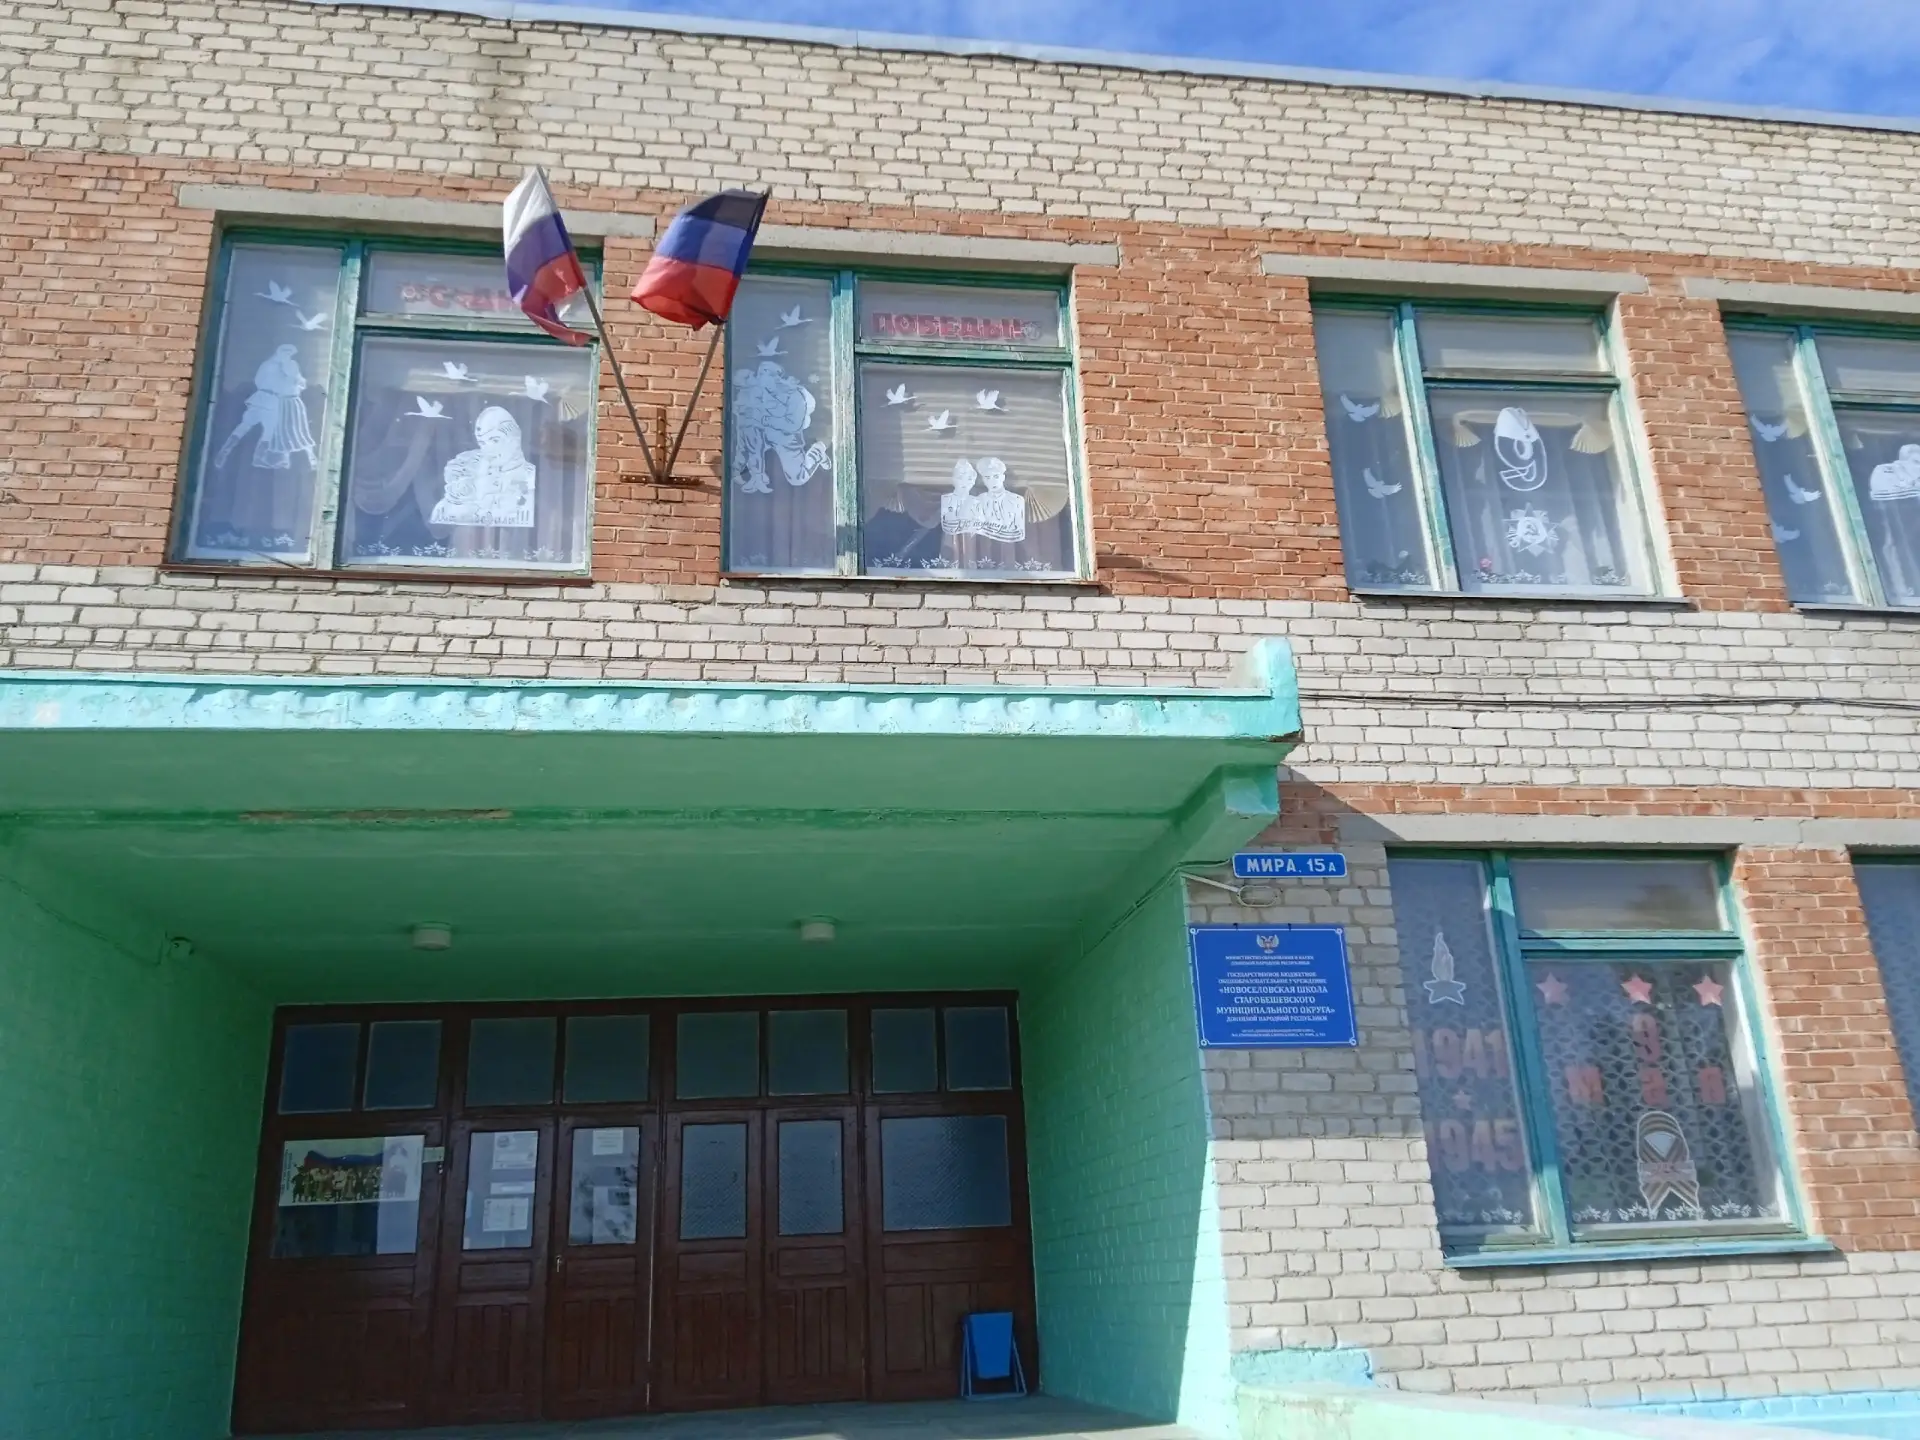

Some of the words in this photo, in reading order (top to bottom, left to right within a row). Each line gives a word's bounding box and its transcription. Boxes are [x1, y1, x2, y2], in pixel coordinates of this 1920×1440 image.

[1219, 985, 1296, 994] «НОВОСЕЛОВСКАЯ
[1297, 985, 1328, 994] ШКОЛА
[1234, 996, 1316, 1004] СТАРОБЕШЕВСКОГО
[1216, 1006, 1299, 1015] МУНИЦИПАЛЬНОГО
[1300, 1006, 1335, 1015] ОКРУГА»
[1412, 1027, 1508, 1079] 1941
[1423, 1118, 1526, 1174] 1945
